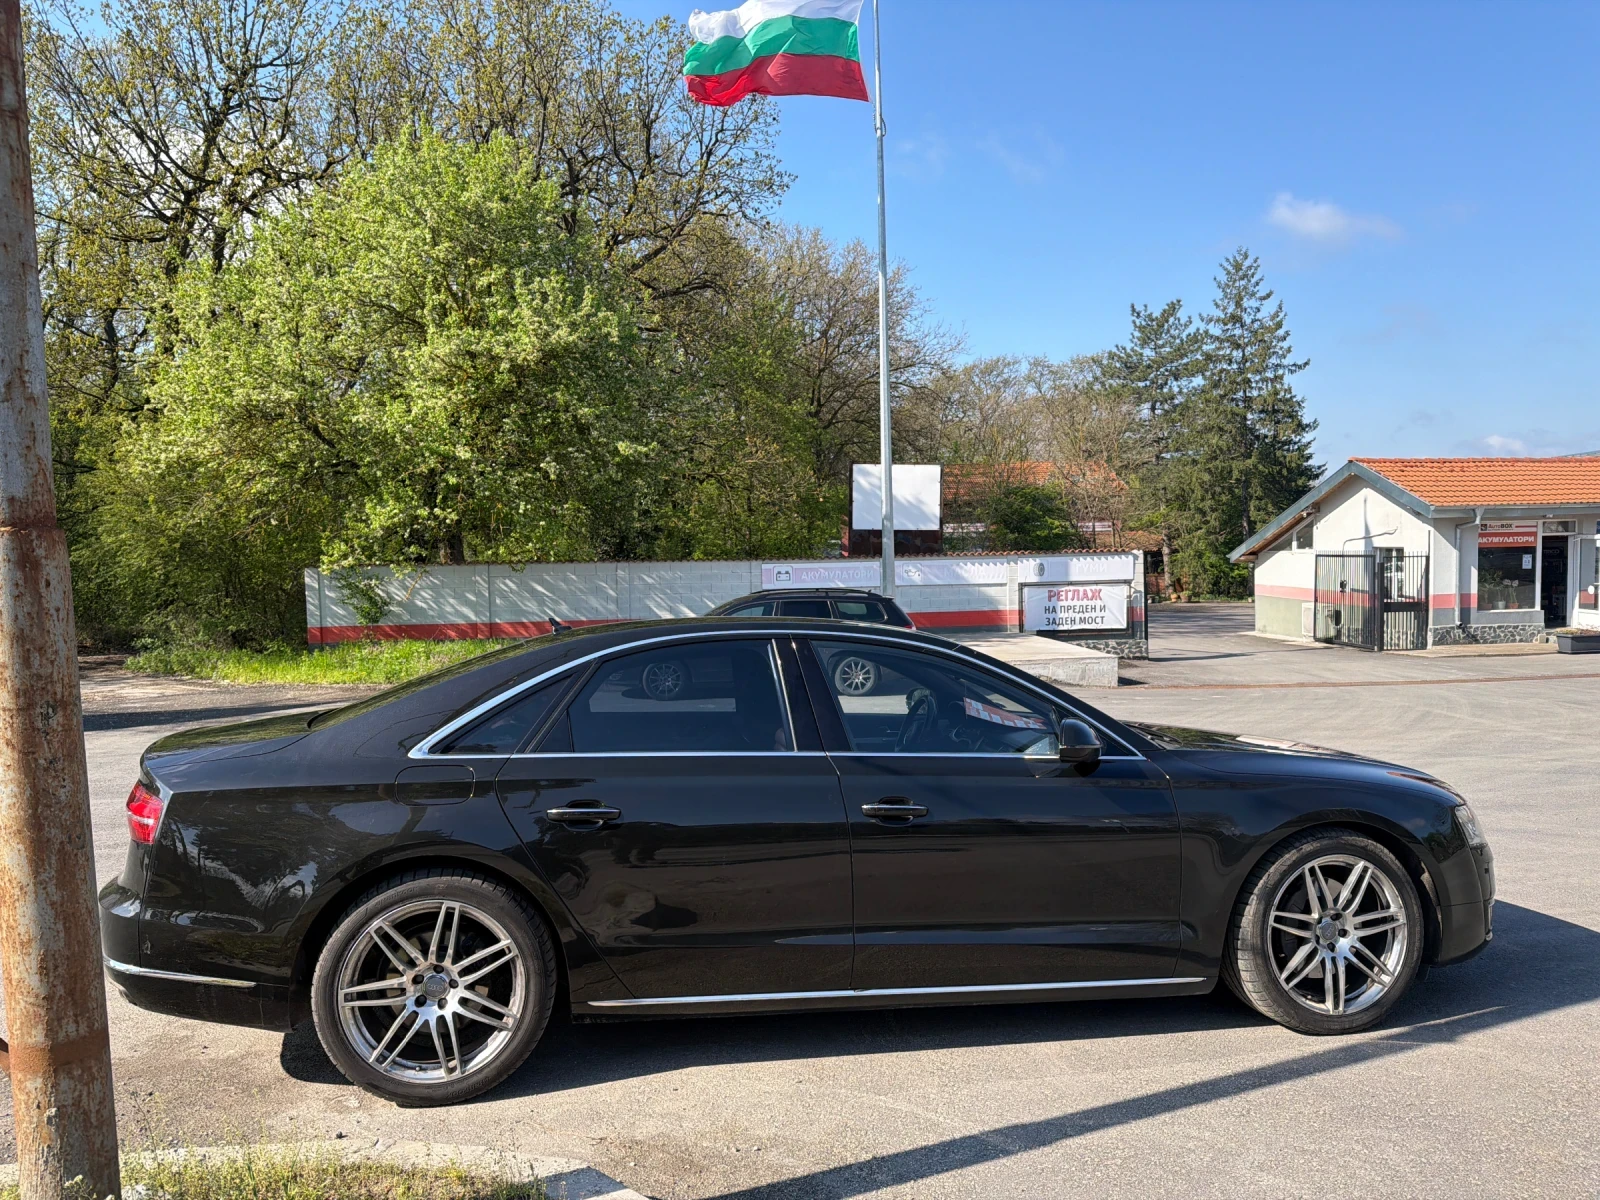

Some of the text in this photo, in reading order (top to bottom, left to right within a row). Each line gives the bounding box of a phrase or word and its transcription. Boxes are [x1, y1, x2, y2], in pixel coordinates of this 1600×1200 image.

[1076, 563, 1107, 573] ГУМИ
[801, 570, 874, 580] АКУМУЛАТОРИ
[1047, 588, 1103, 602] РЕГЛАЖ
[1044, 604, 1106, 614] НА ПРЕДЕН И
[1045, 616, 1105, 627] ЗАДЕН МОСТ
